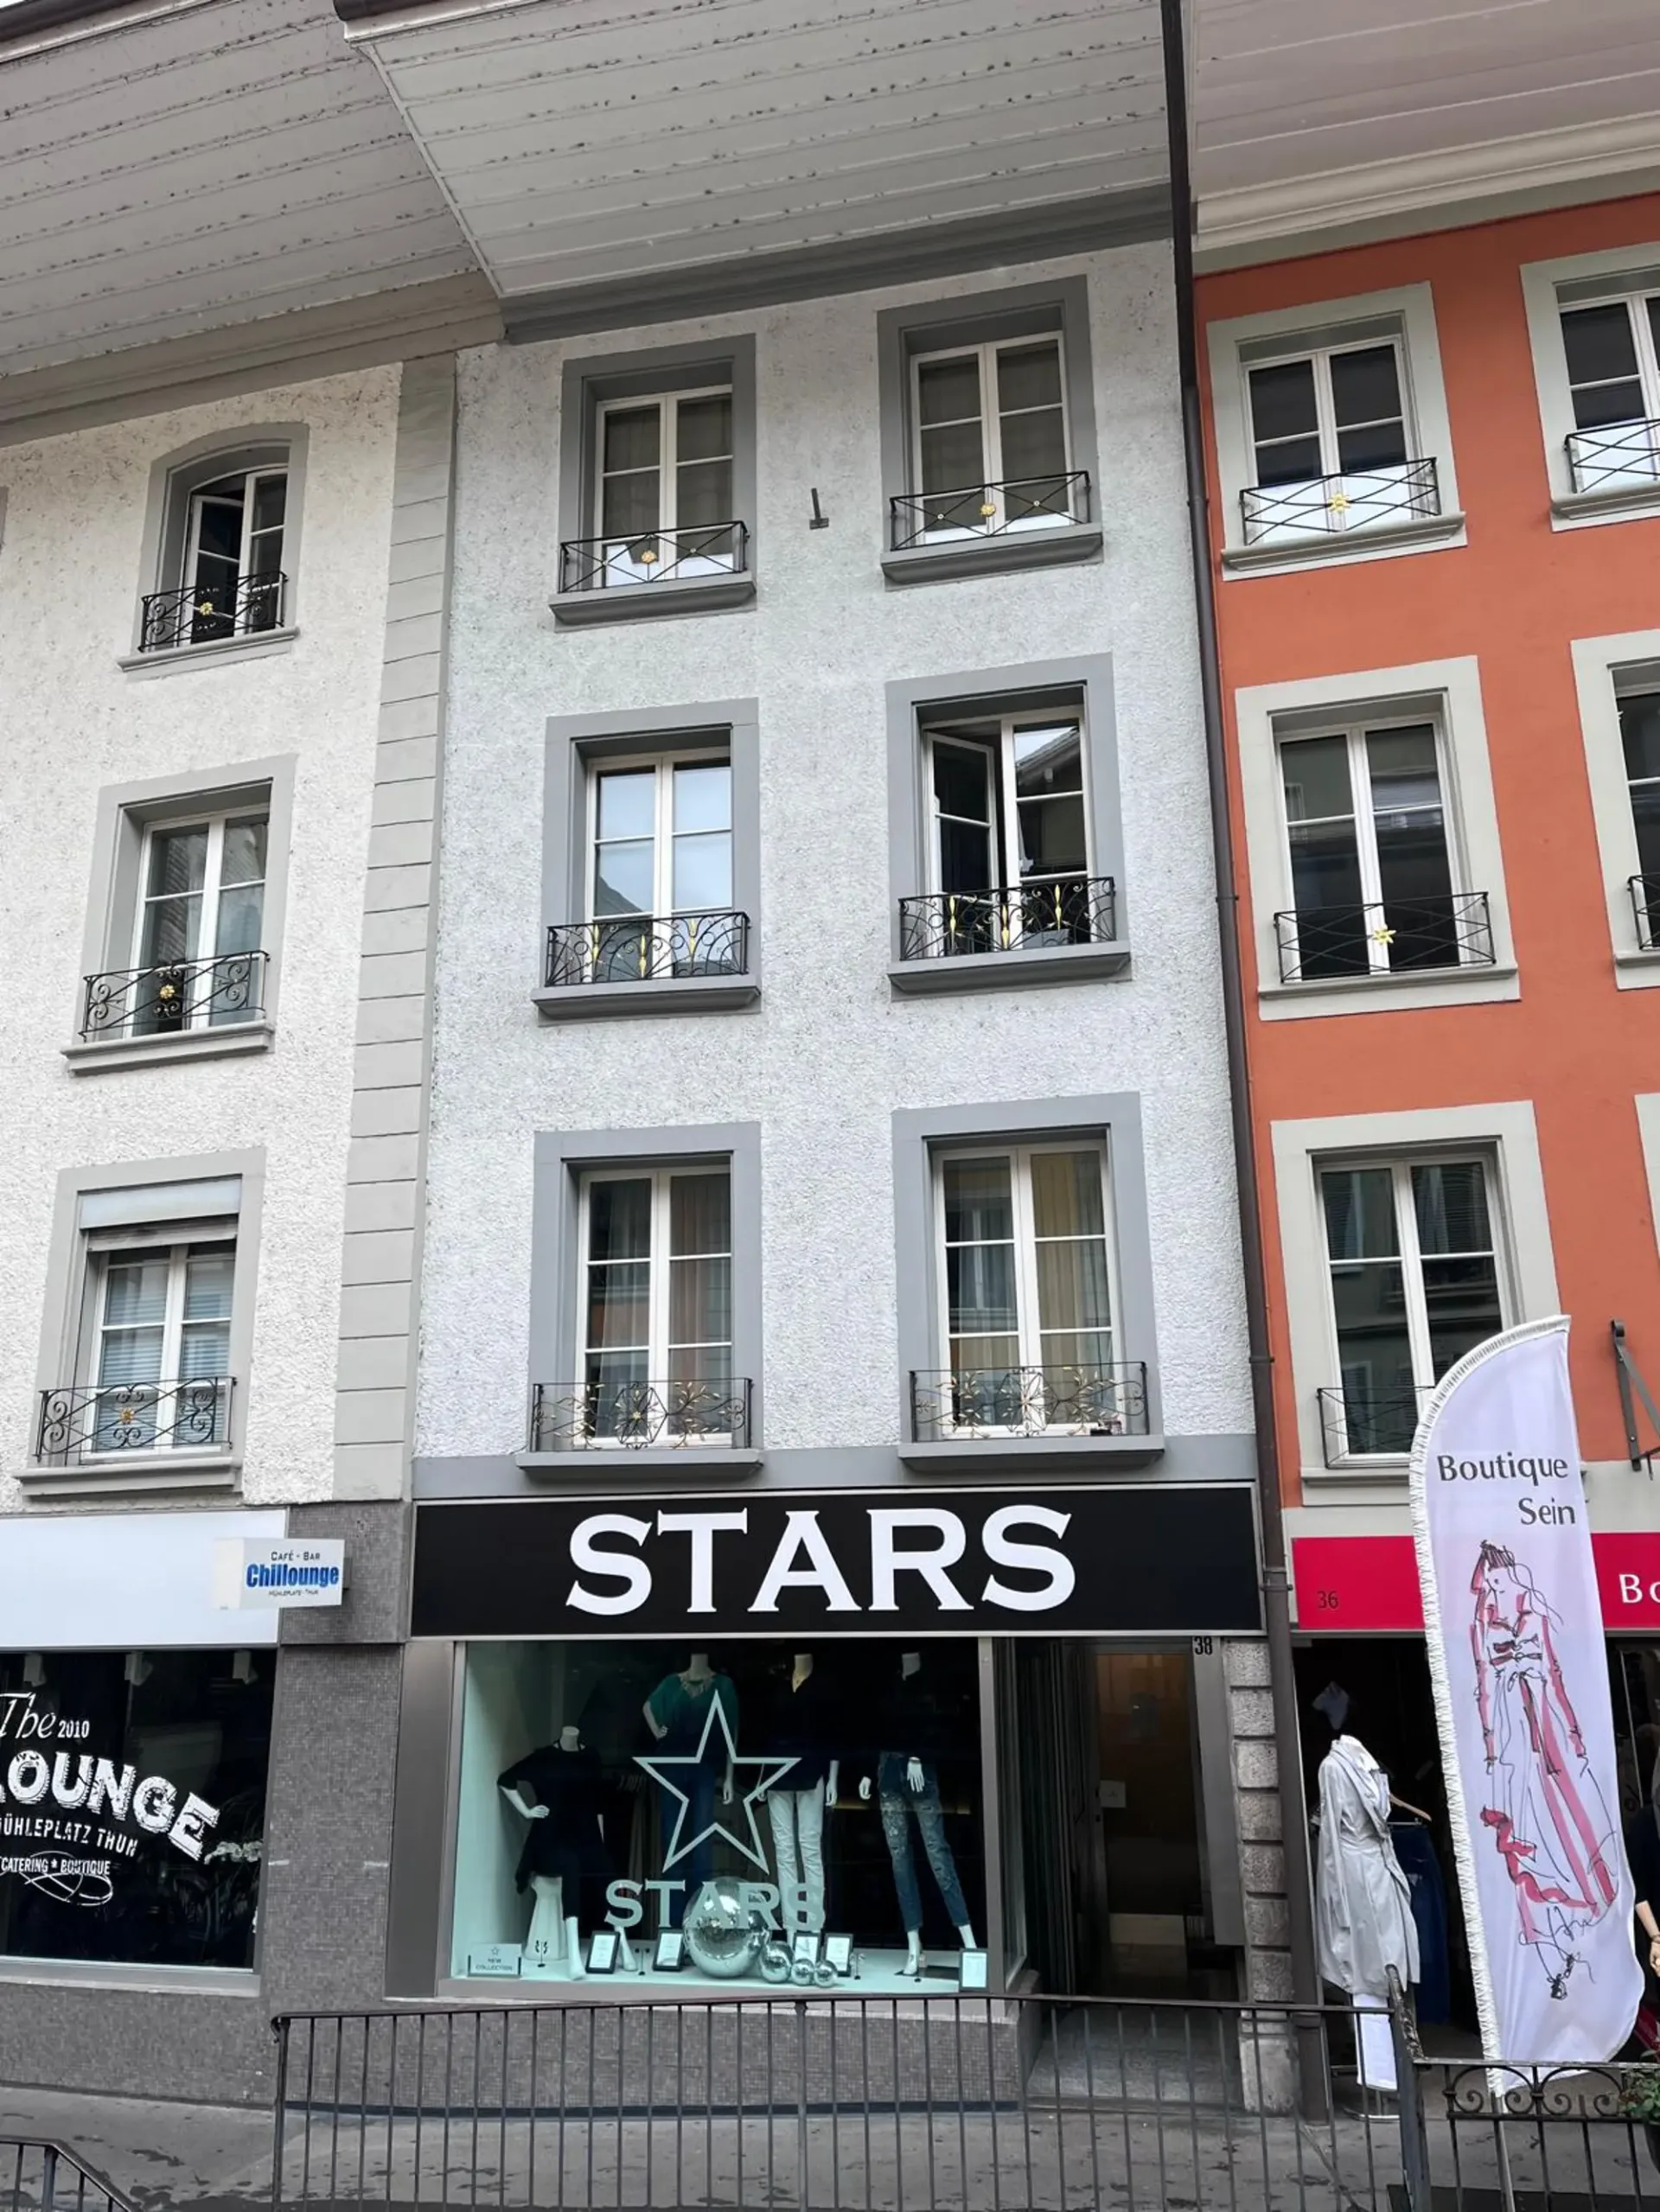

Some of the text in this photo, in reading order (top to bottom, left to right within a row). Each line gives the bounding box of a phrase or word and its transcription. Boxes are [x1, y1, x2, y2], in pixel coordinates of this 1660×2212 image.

[1437, 1451, 1569, 1487] Boutique
[1518, 1497, 1576, 1526] Sein
[303, 1552, 321, 1560] BAR
[565, 1504, 1076, 1616] STARS
[246, 1563, 340, 1588] Chillounge
[1318, 1590, 1339, 1609] 36
[1194, 1635, 1213, 1655] 38
[0, 1692, 90, 1739] The 2010
[0, 1750, 220, 1861] OUNGE
[0, 1813, 138, 1857] ÜHLEPLATZ THUN
[1, 1856, 111, 1875] CATERING BOUTIQUE
[604, 1878, 826, 1931] STARS
